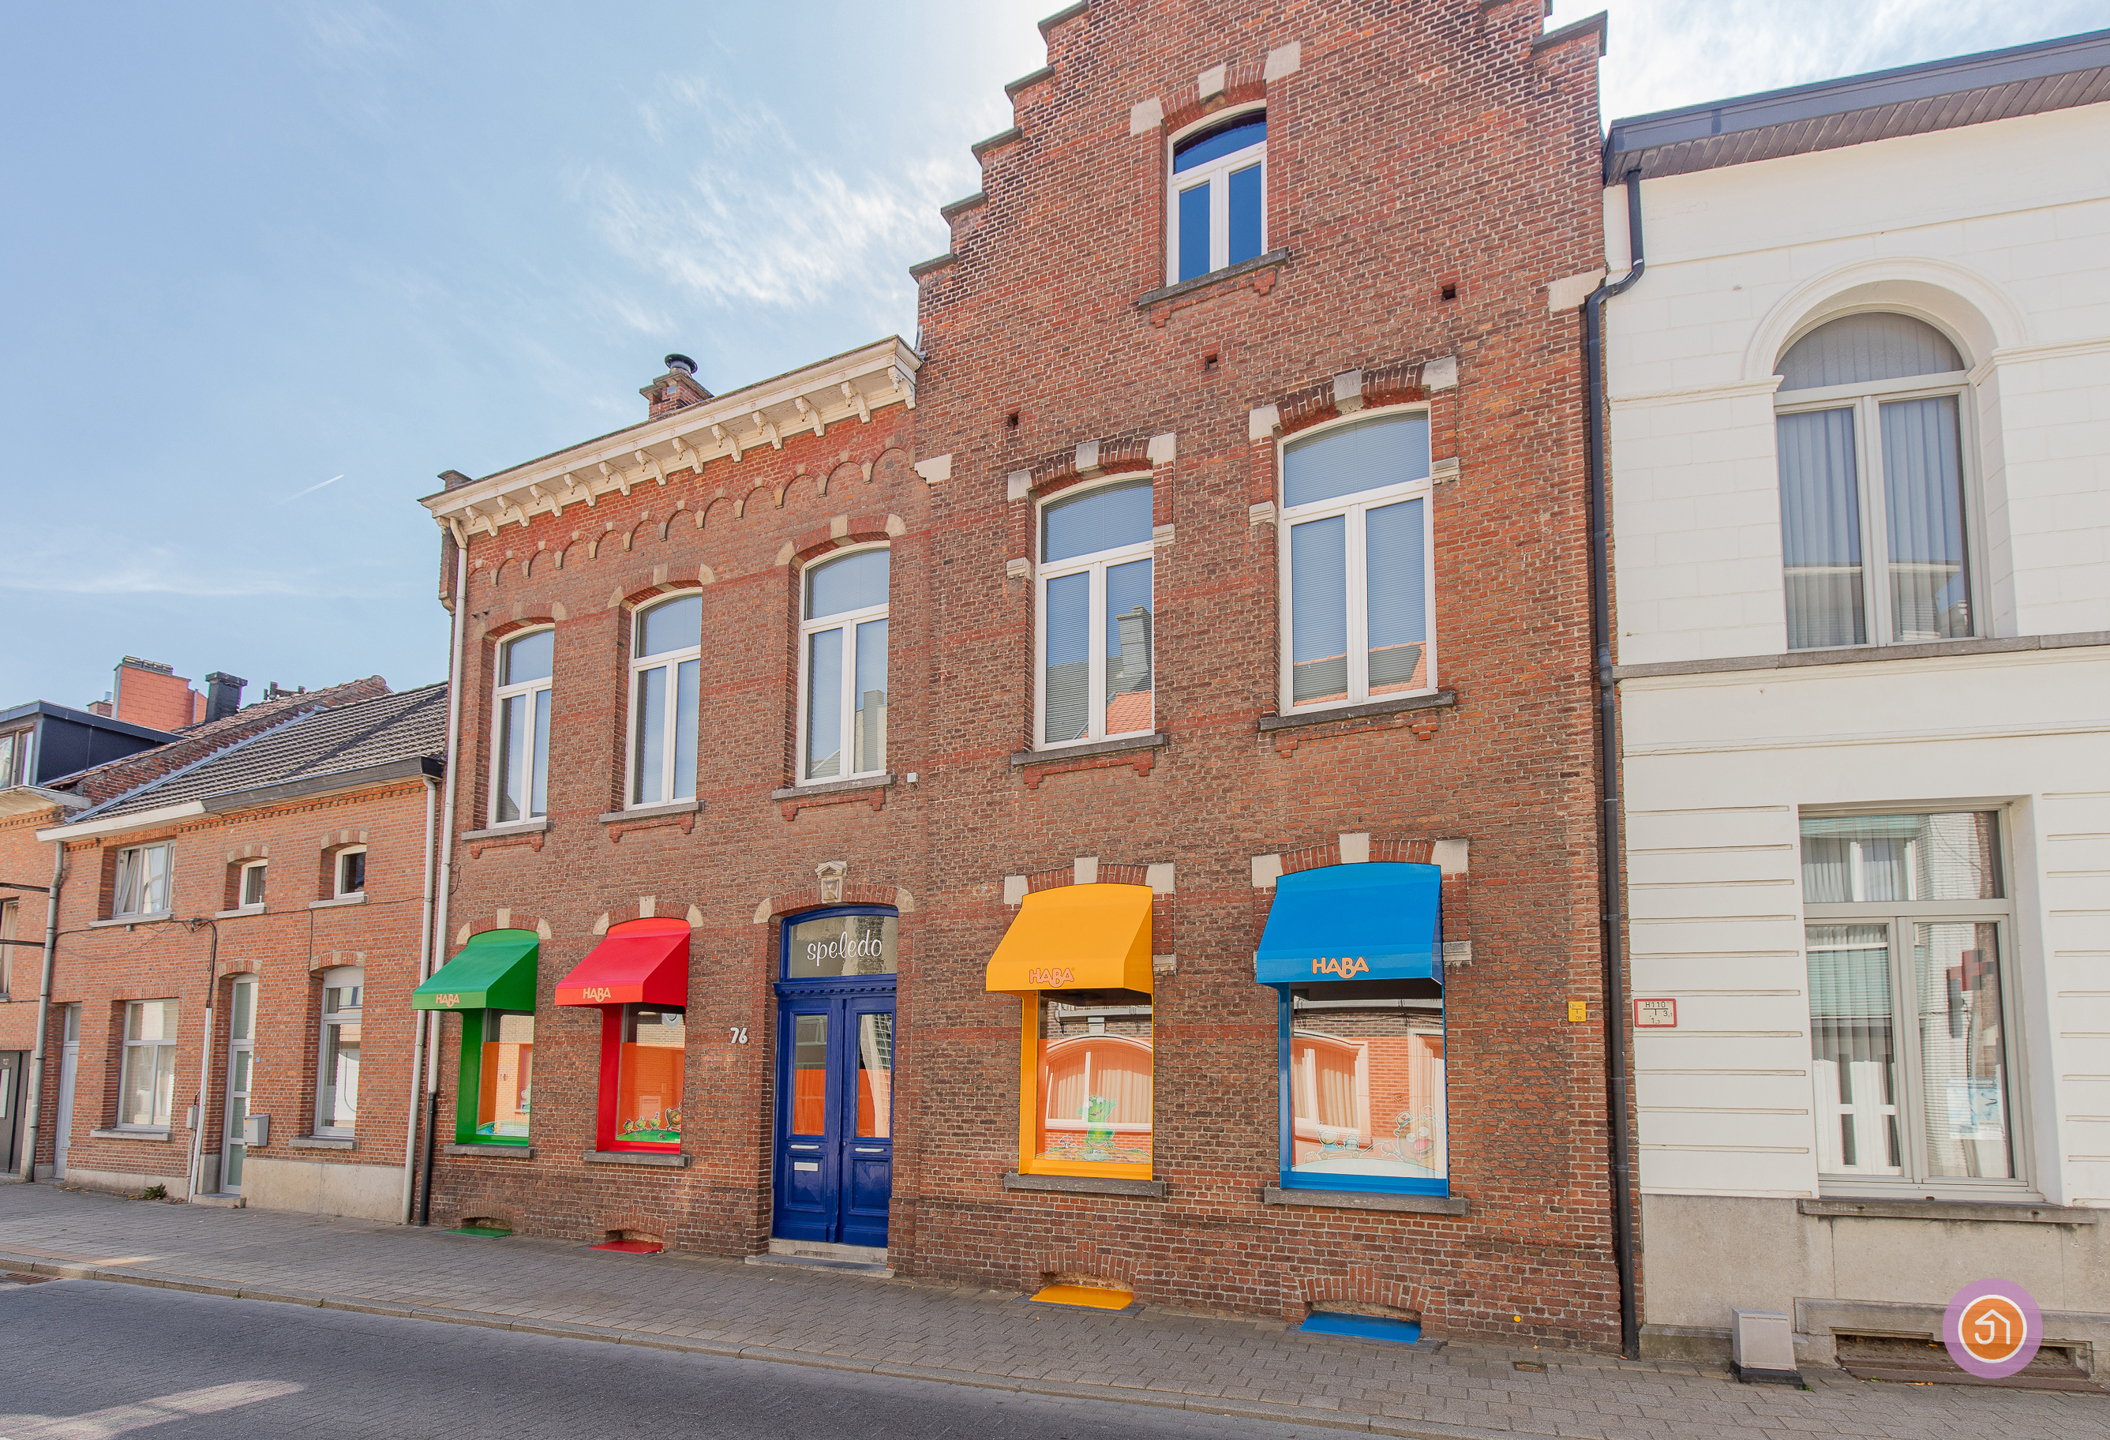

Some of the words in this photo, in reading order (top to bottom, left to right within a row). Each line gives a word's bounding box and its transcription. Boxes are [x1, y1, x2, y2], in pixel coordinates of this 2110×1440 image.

[807, 929, 882, 967] speledo
[1312, 956, 1370, 979] HABA
[1029, 967, 1075, 988] HABA
[435, 993, 460, 1009] HABA
[582, 986, 612, 1003] HABA
[730, 1027, 748, 1044] 76
